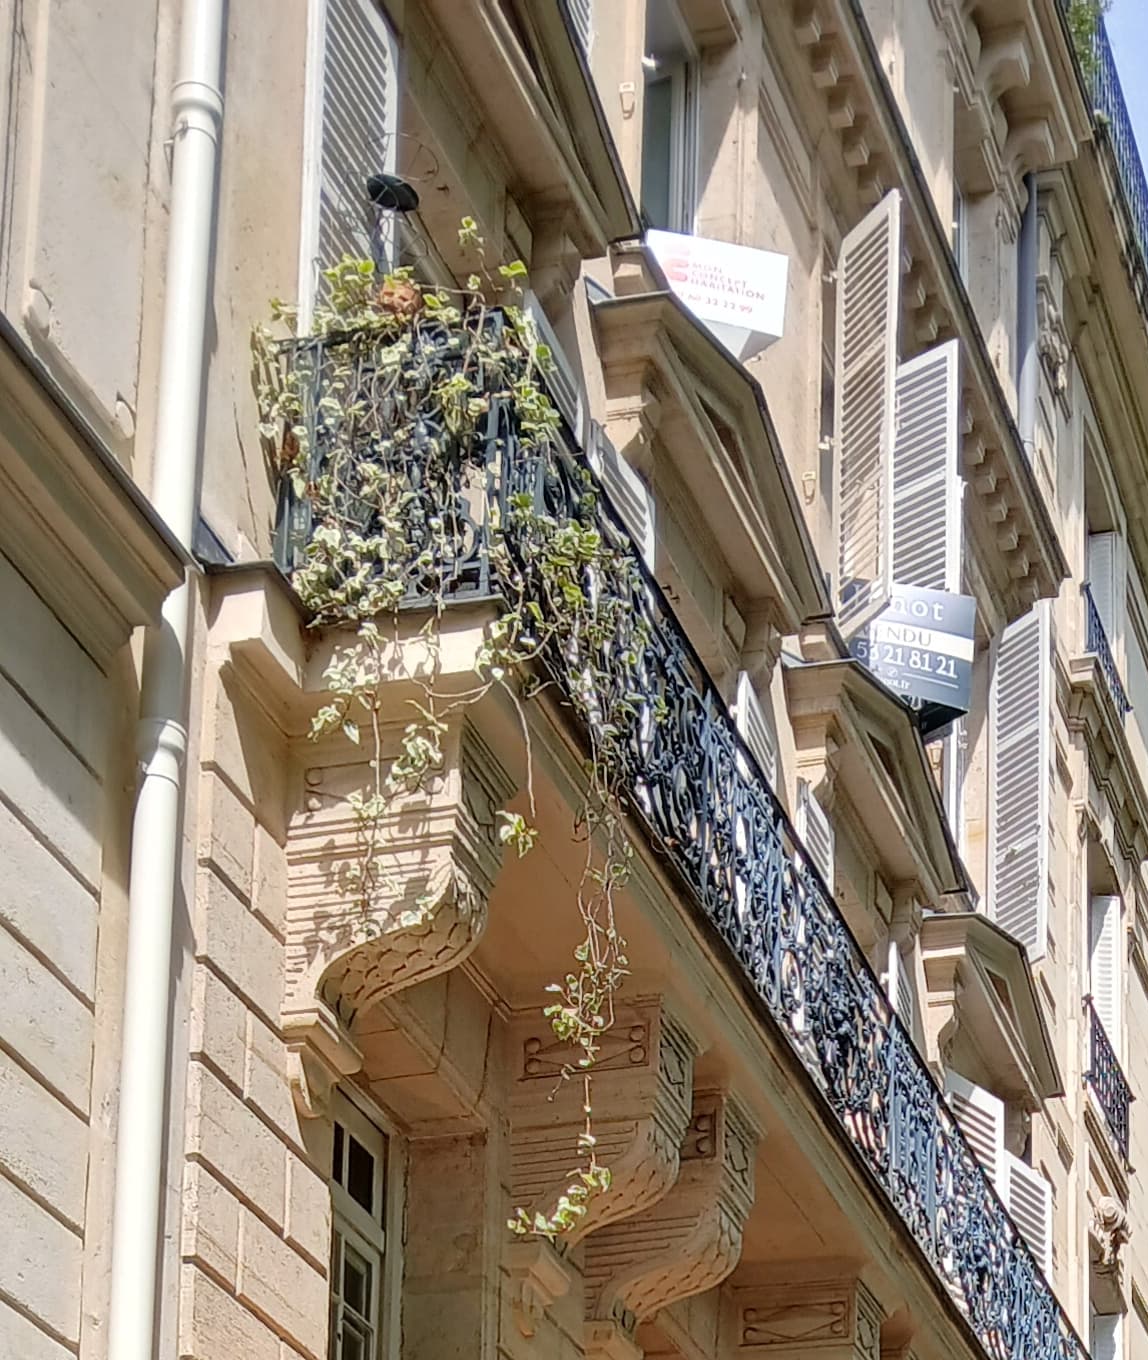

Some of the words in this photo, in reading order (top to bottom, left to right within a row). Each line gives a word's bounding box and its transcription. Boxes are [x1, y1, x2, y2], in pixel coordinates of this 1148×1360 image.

[883, 645, 905, 666] 21
[909, 651, 932, 672] 81
[936, 656, 958, 678] 21
